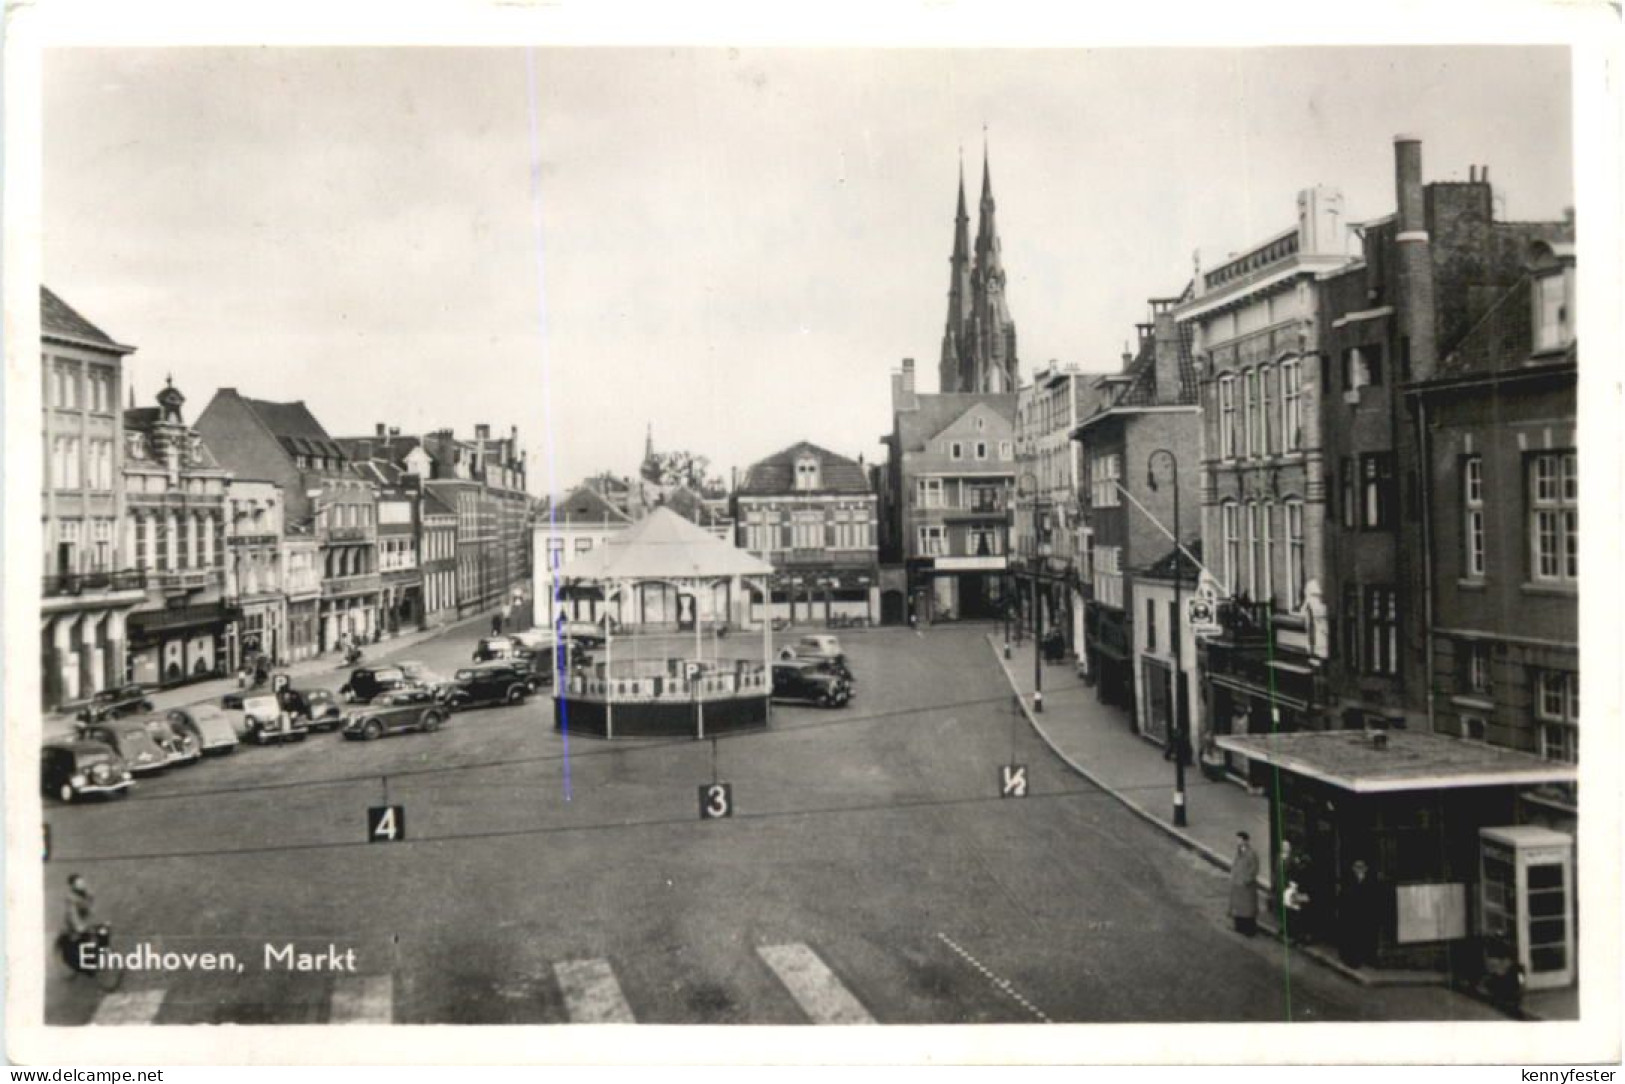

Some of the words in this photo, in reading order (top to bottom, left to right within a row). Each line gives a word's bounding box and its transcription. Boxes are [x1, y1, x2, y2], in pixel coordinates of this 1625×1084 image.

[275, 675, 288, 692] P
[687, 663, 699, 680] P
[708, 785, 726, 817] 3
[375, 807, 397, 840] 4
